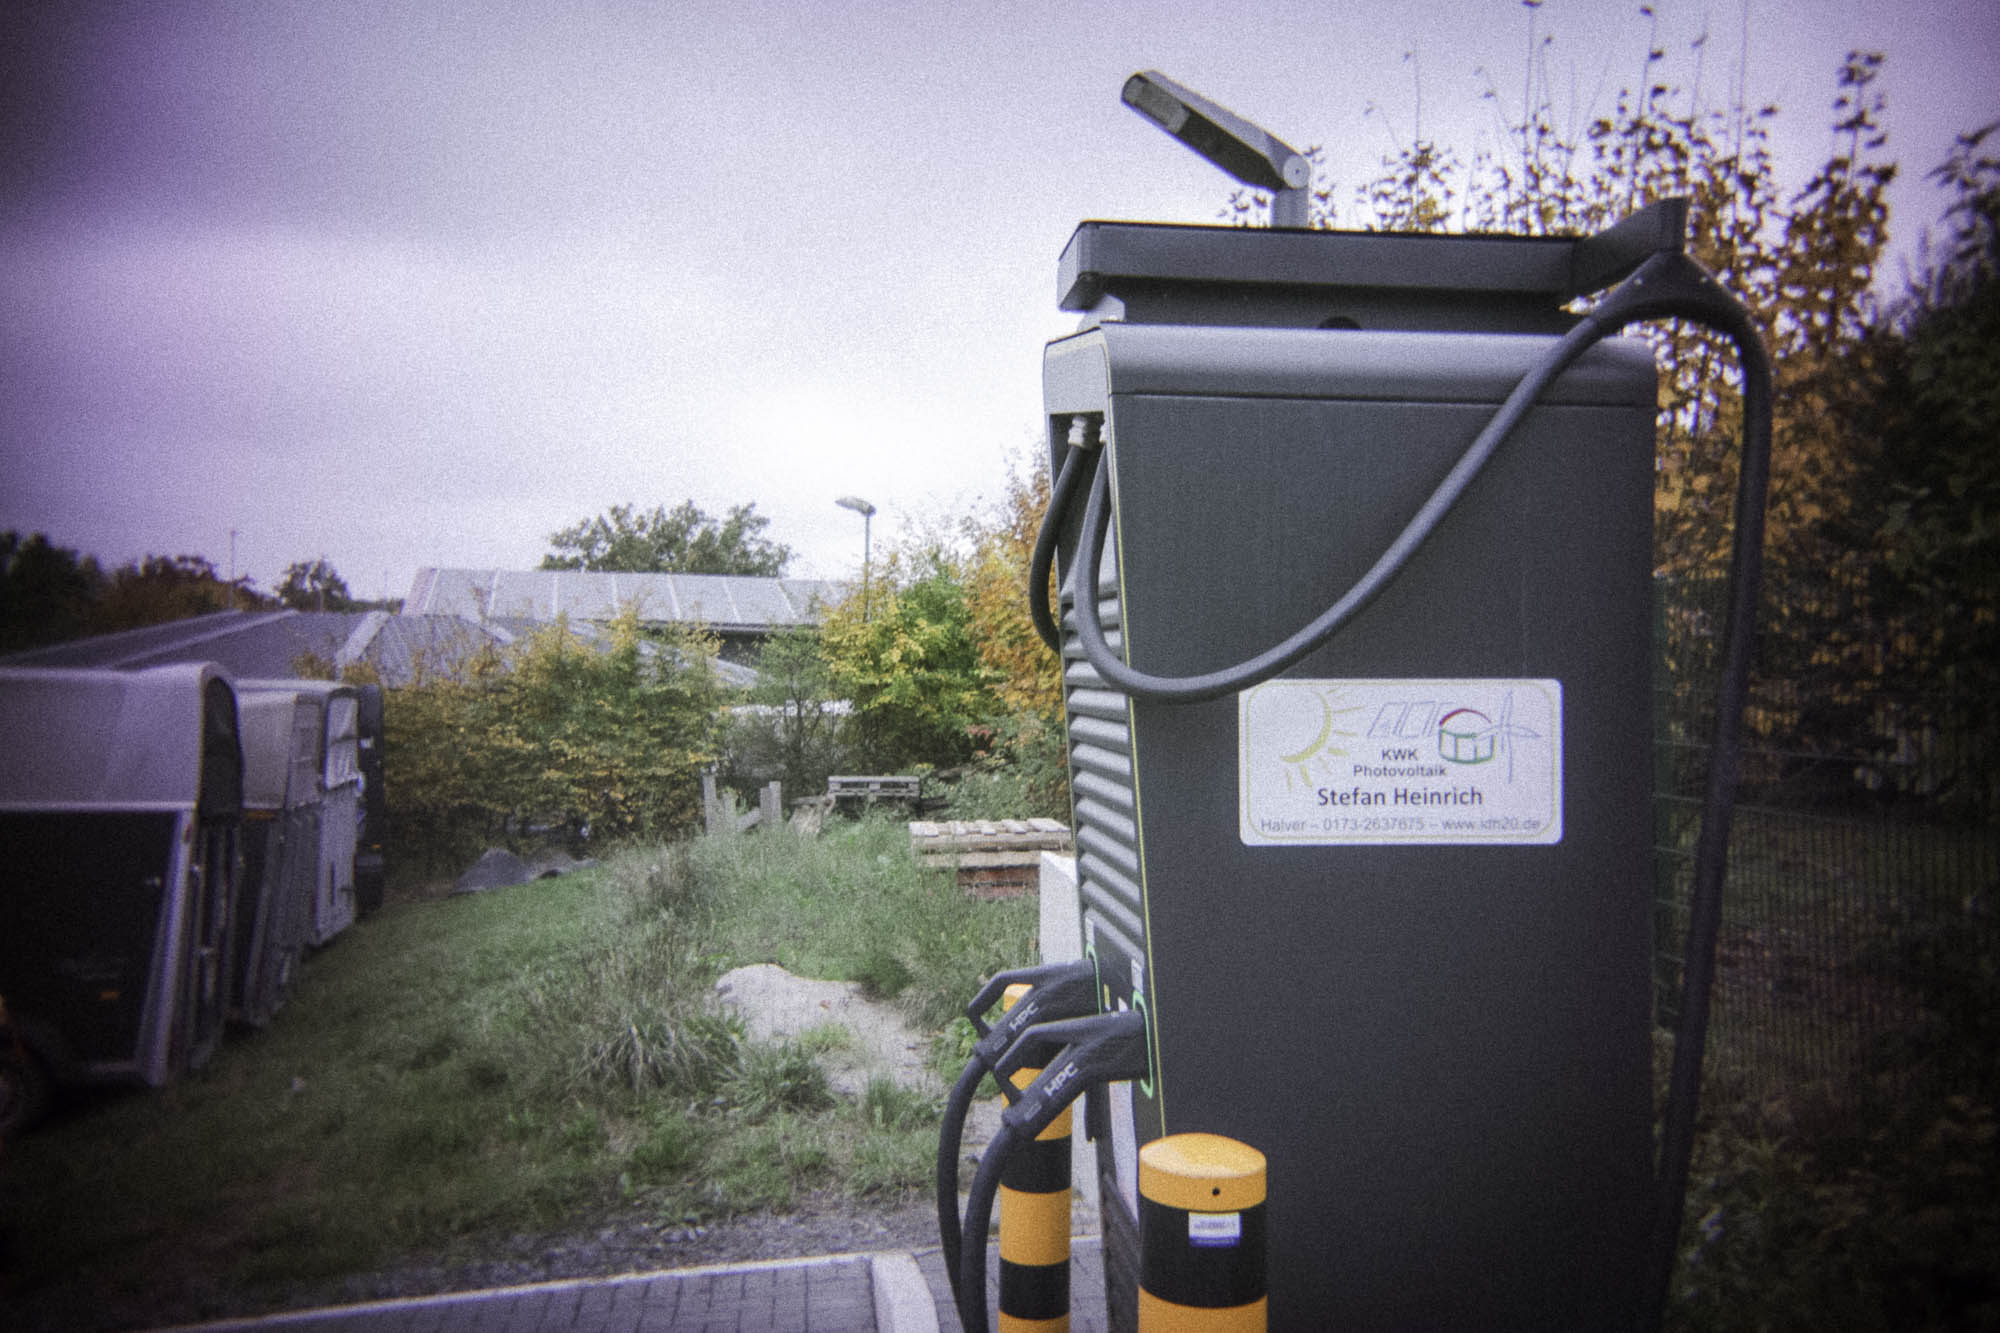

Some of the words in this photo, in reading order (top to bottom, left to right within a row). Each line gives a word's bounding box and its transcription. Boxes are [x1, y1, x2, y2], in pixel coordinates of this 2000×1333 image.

[1381, 748, 1418, 761] KWK
[1353, 764, 1447, 777] Photovoltaik
[1317, 786, 1386, 806] Stefan
[1394, 785, 1483, 806] Heinrich
[1008, 1002, 1040, 1033] HPC
[1043, 1061, 1079, 1097] HPC
